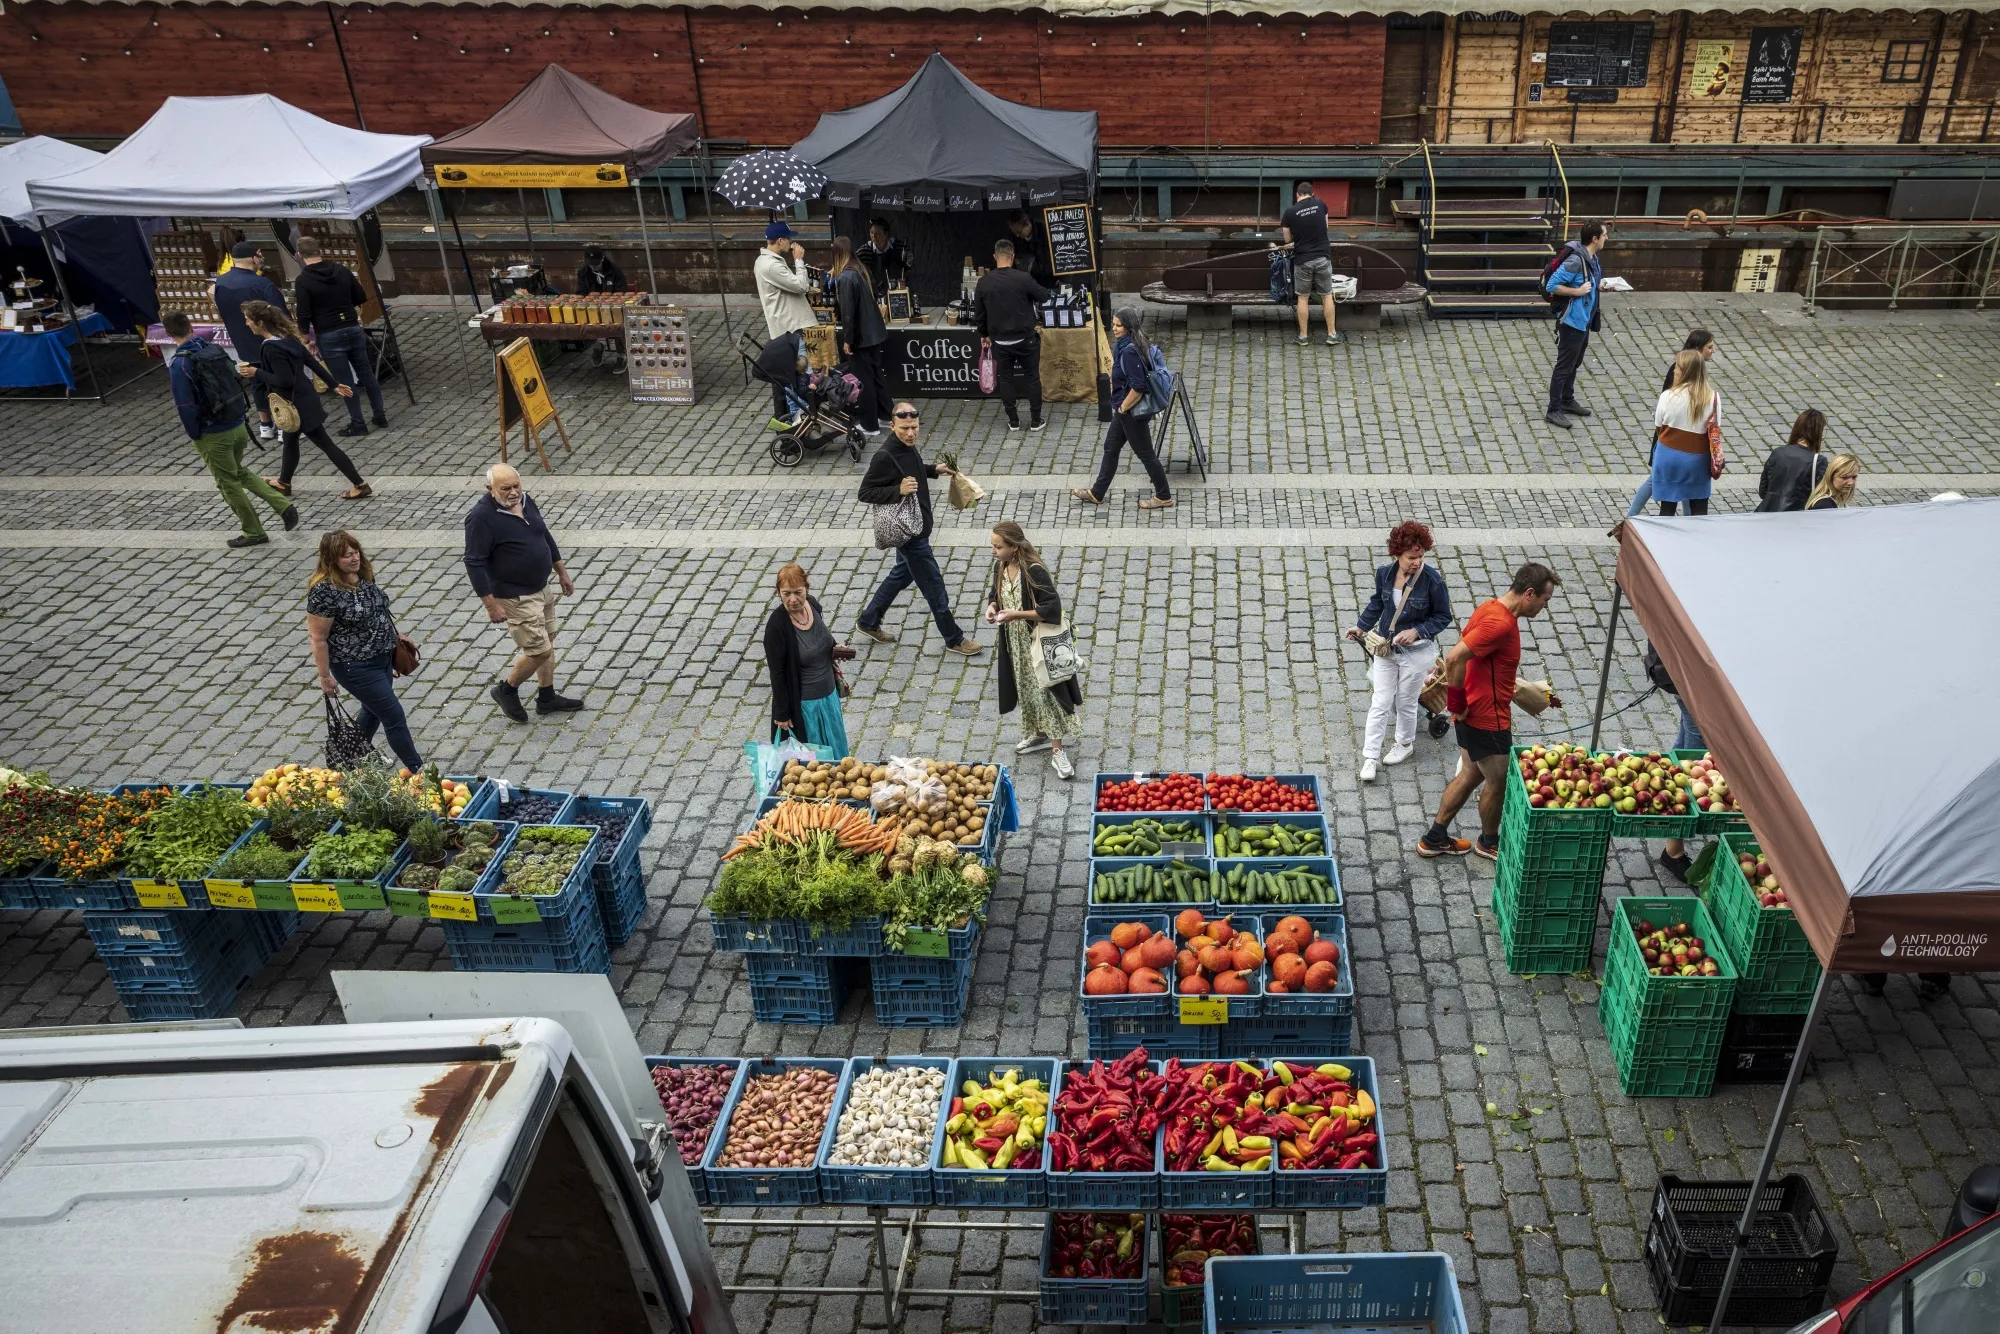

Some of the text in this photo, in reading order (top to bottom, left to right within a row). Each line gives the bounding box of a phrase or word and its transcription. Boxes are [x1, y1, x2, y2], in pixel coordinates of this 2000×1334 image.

[906, 338, 972, 359] Coffee
[901, 363, 980, 382] Friends
[1901, 933, 1988, 945] ANTI-POOLING
[1900, 945, 1980, 957] TECHNOLOGY
